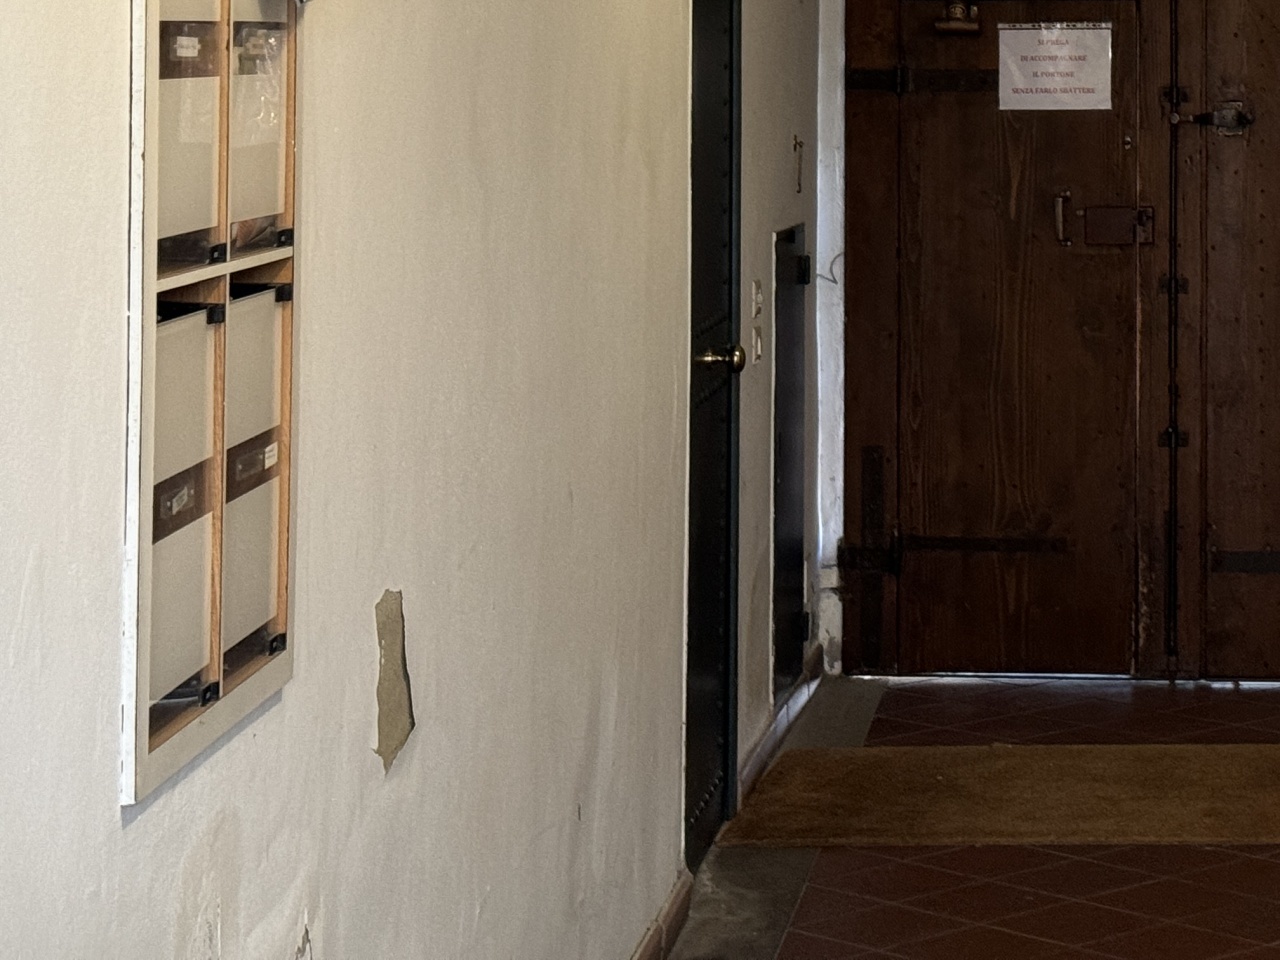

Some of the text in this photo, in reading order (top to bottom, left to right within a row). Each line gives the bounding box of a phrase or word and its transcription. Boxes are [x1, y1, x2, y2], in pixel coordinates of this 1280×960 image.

[1020, 54, 1028, 62] DI
[1011, 87, 1096, 95] SENZA FARLO SBATTERE
